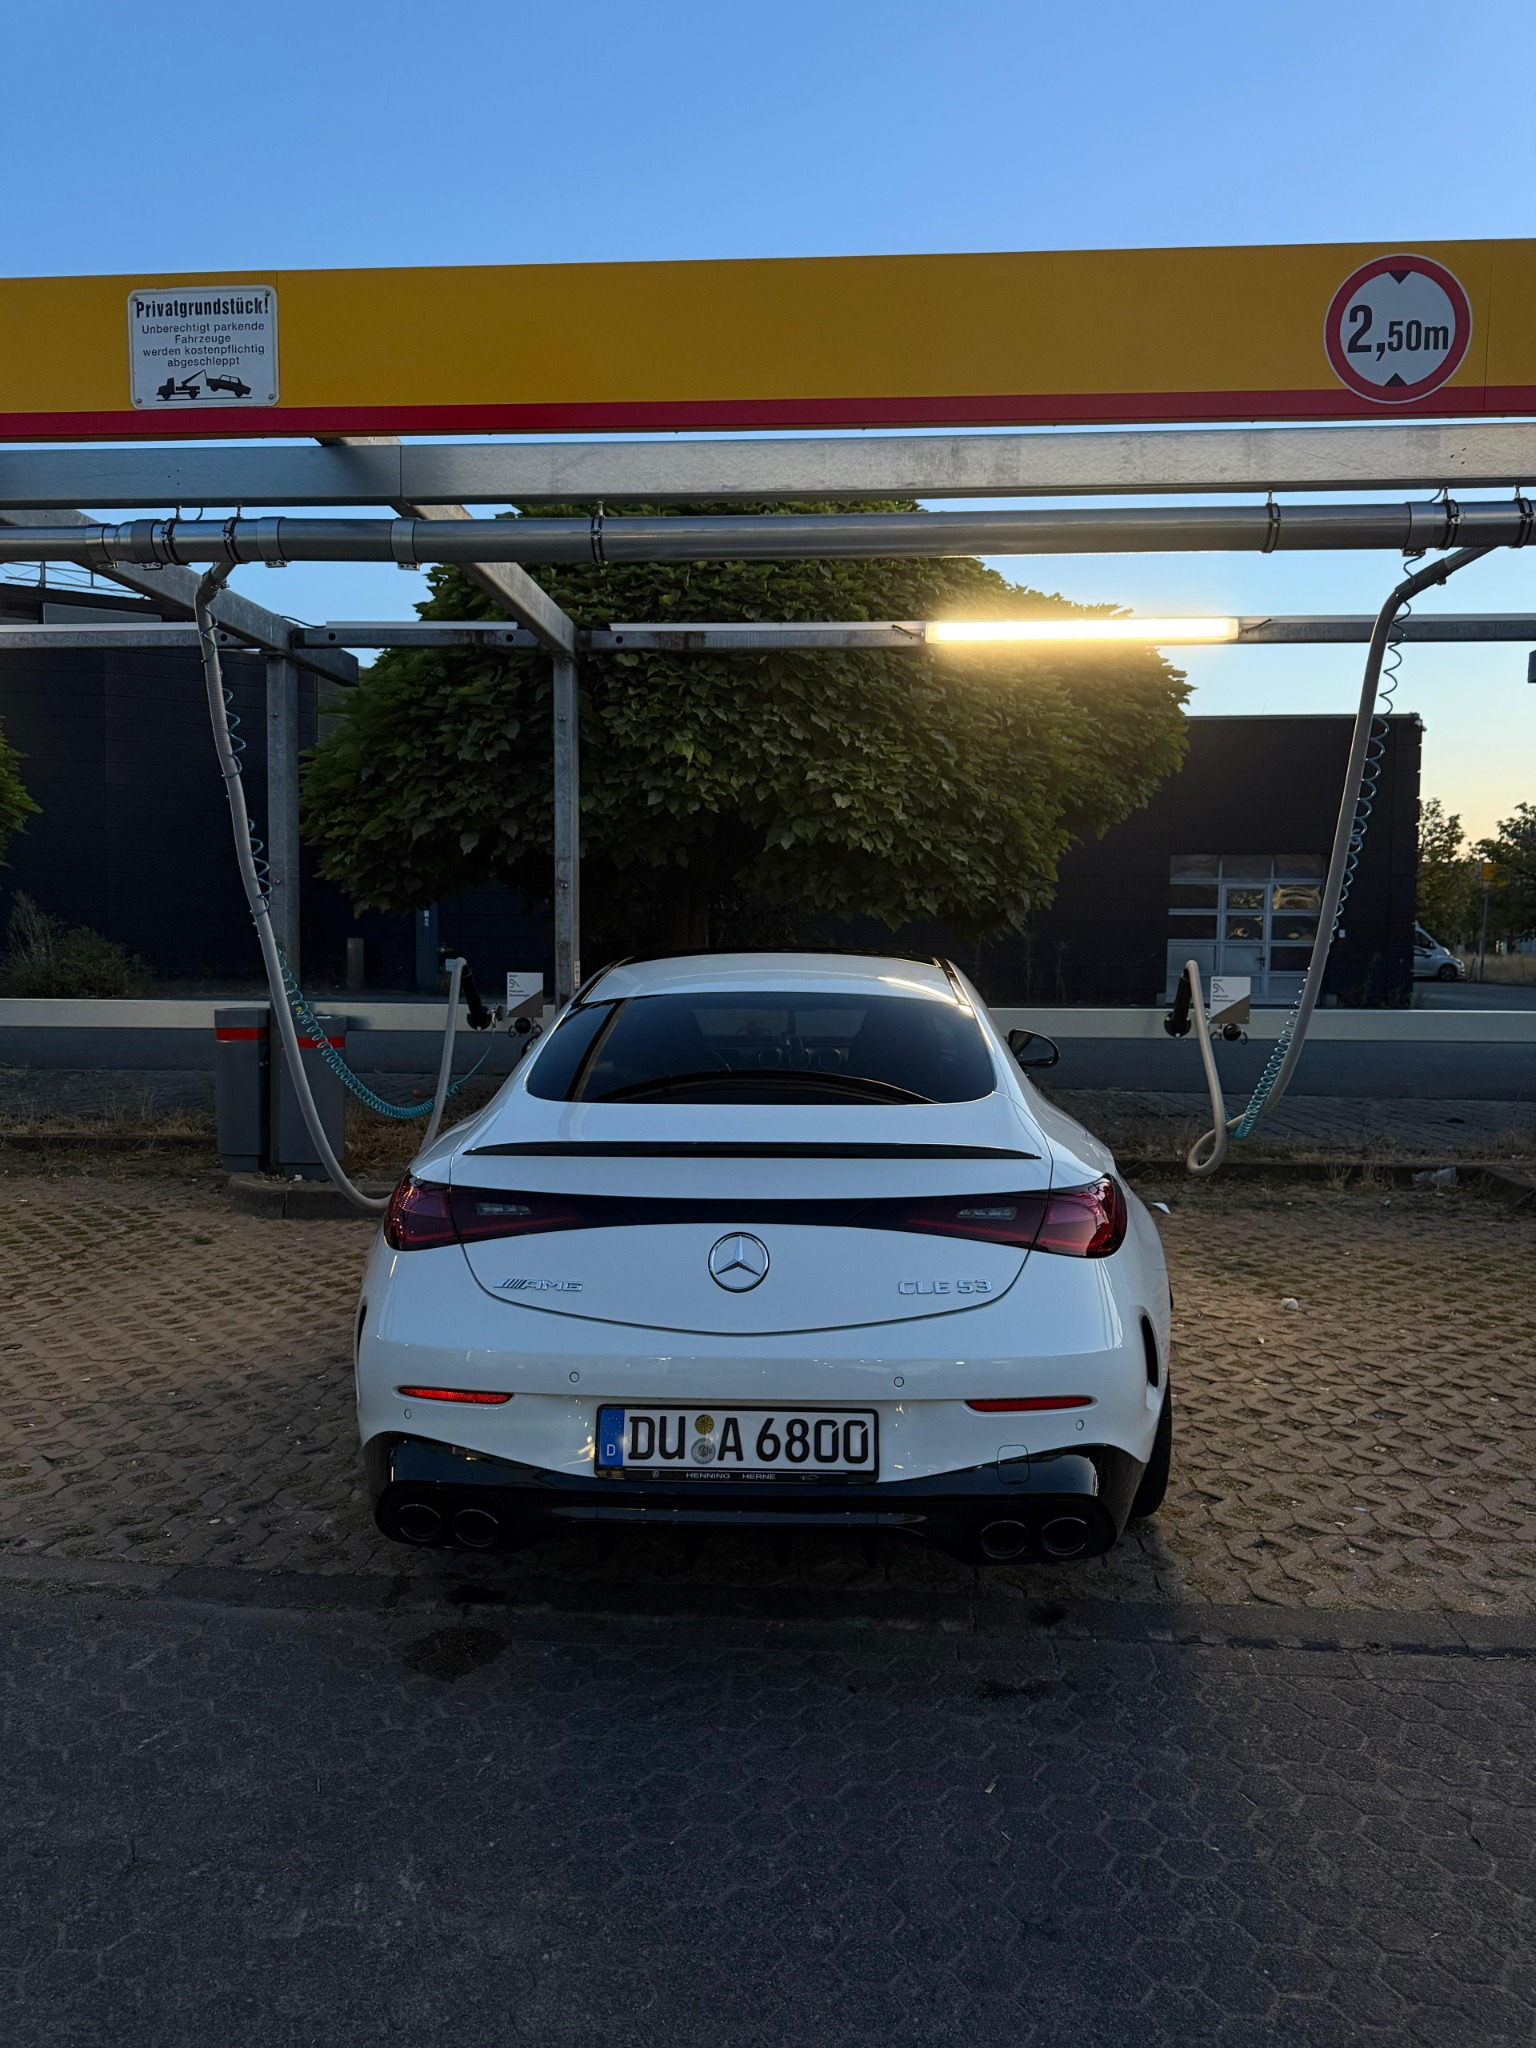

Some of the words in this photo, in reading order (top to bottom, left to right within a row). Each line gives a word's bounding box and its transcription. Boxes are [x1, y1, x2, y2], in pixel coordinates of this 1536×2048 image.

[136, 297, 269, 318] Privatgrundstück!
[142, 323, 210, 334] Unberechtigt
[213, 321, 264, 333] parkende
[1347, 304, 1449, 361] 2,50m
[175, 334, 231, 345] Fahrzeuge
[143, 346, 181, 357] werden
[184, 344, 265, 356] kostenpflichtig
[167, 356, 240, 368] abgeschleppt
[521, 1278, 583, 1292] AMG
[898, 1280, 951, 1295] CLE
[957, 1279, 993, 1294] 53
[628, 1415, 686, 1460] DU
[717, 1417, 744, 1462] A
[756, 1418, 869, 1464] 6800
[606, 1443, 616, 1457] D
[686, 1472, 731, 1480] HENNING
